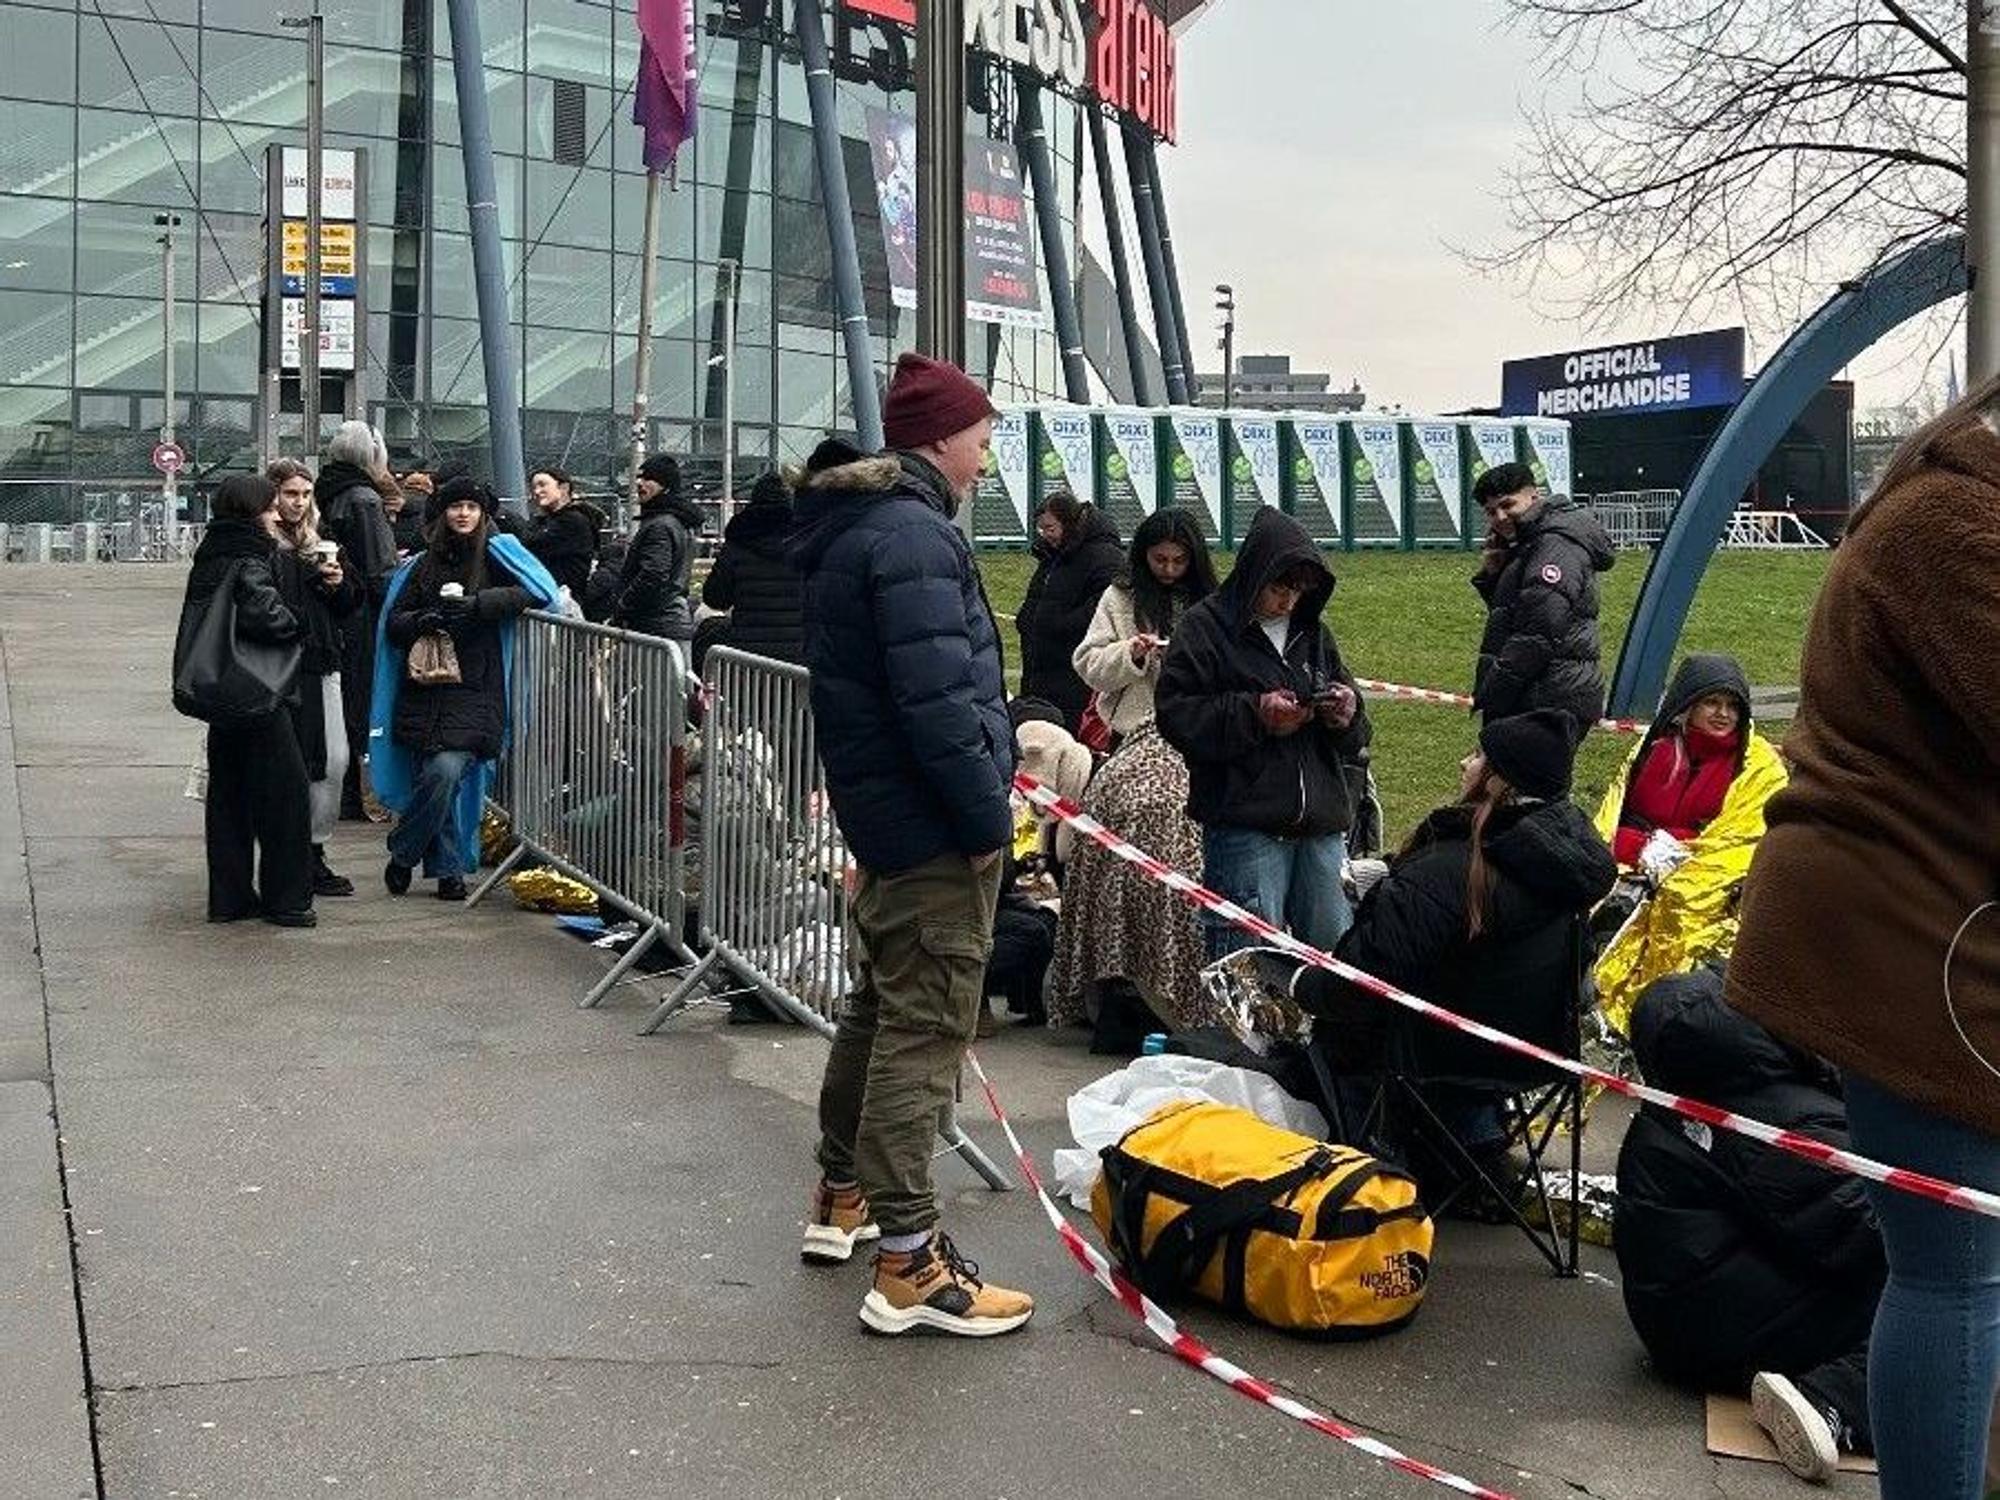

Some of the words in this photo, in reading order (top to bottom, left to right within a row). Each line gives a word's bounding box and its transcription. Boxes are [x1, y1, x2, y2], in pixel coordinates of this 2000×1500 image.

[1564, 344, 1661, 383] OFFICIAL
[1537, 373, 1691, 417] MERCHANDISE
[1383, 1253, 1407, 1270] THE
[1360, 1268, 1409, 1288] NORTH
[1373, 1283, 1409, 1301] FACE
